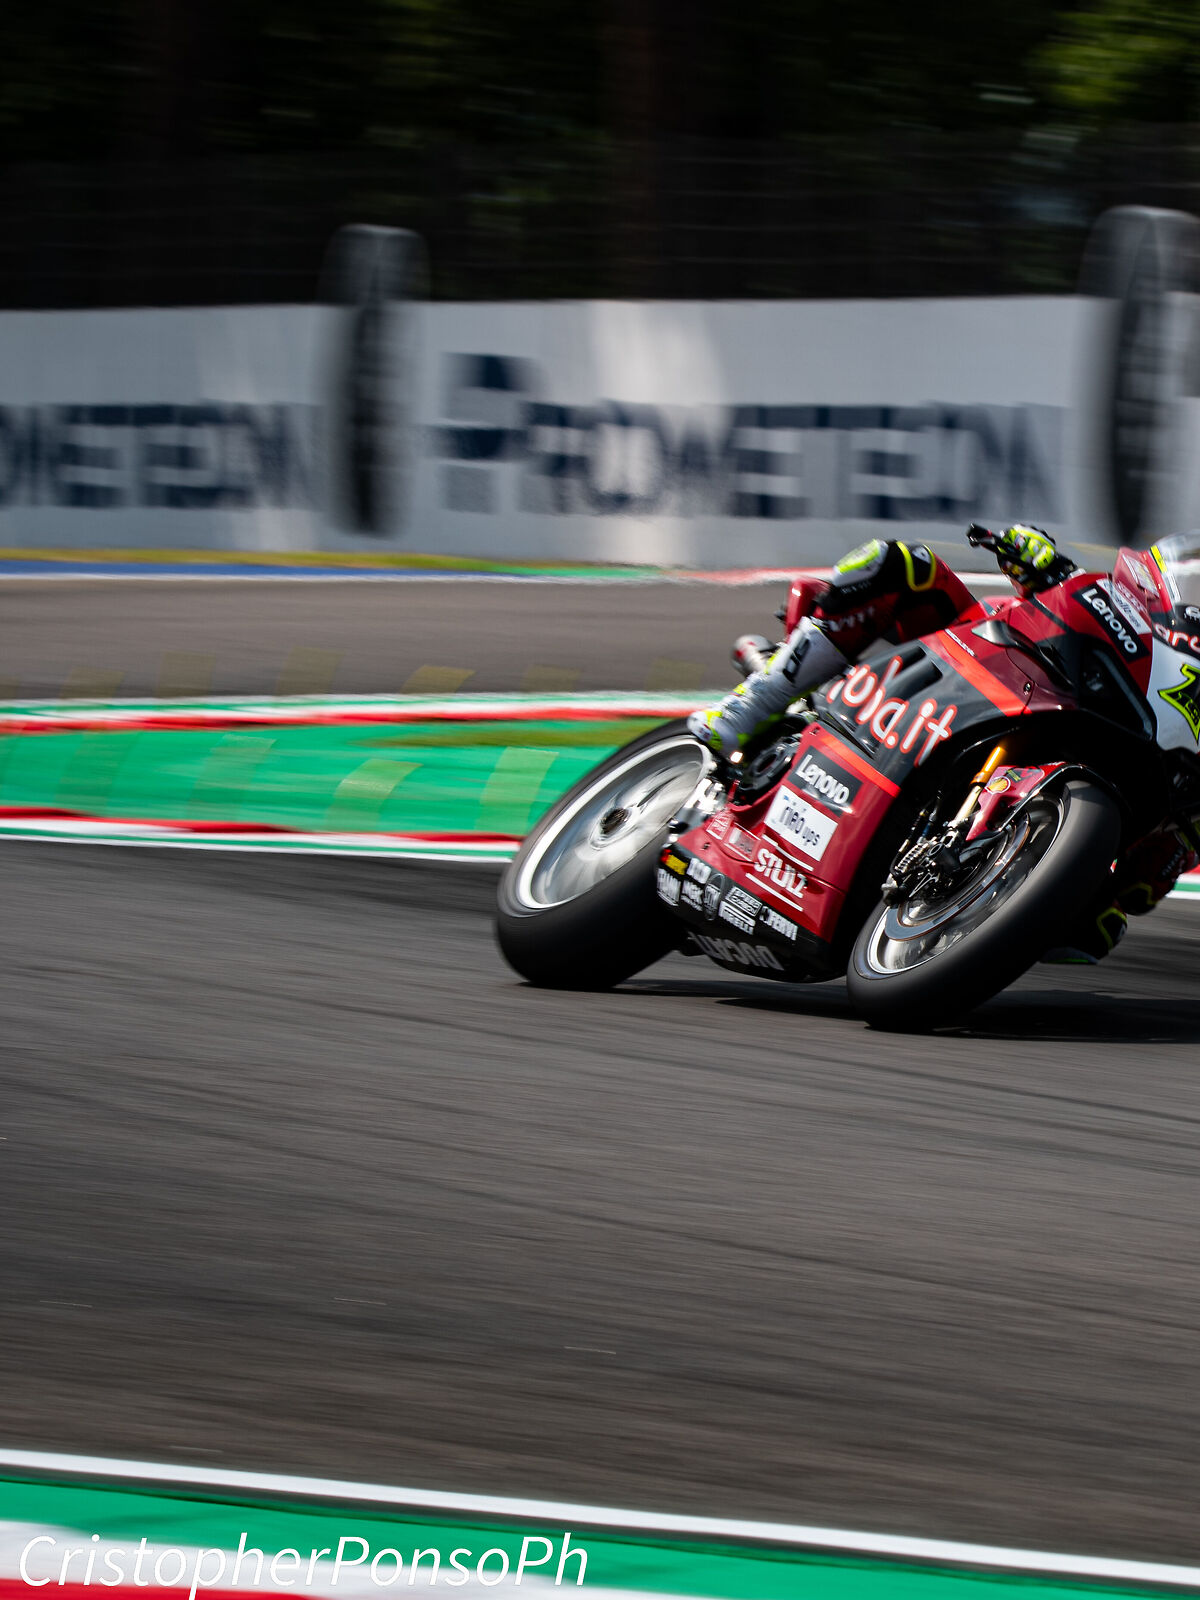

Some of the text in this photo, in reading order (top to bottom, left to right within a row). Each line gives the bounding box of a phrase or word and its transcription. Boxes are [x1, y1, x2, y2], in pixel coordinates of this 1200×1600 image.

[430, 352, 1068, 521] PROMETEON
[1081, 587, 1138, 654] Lenovo
[795, 753, 850, 804] Lenovo
[753, 848, 808, 899] STULZ
